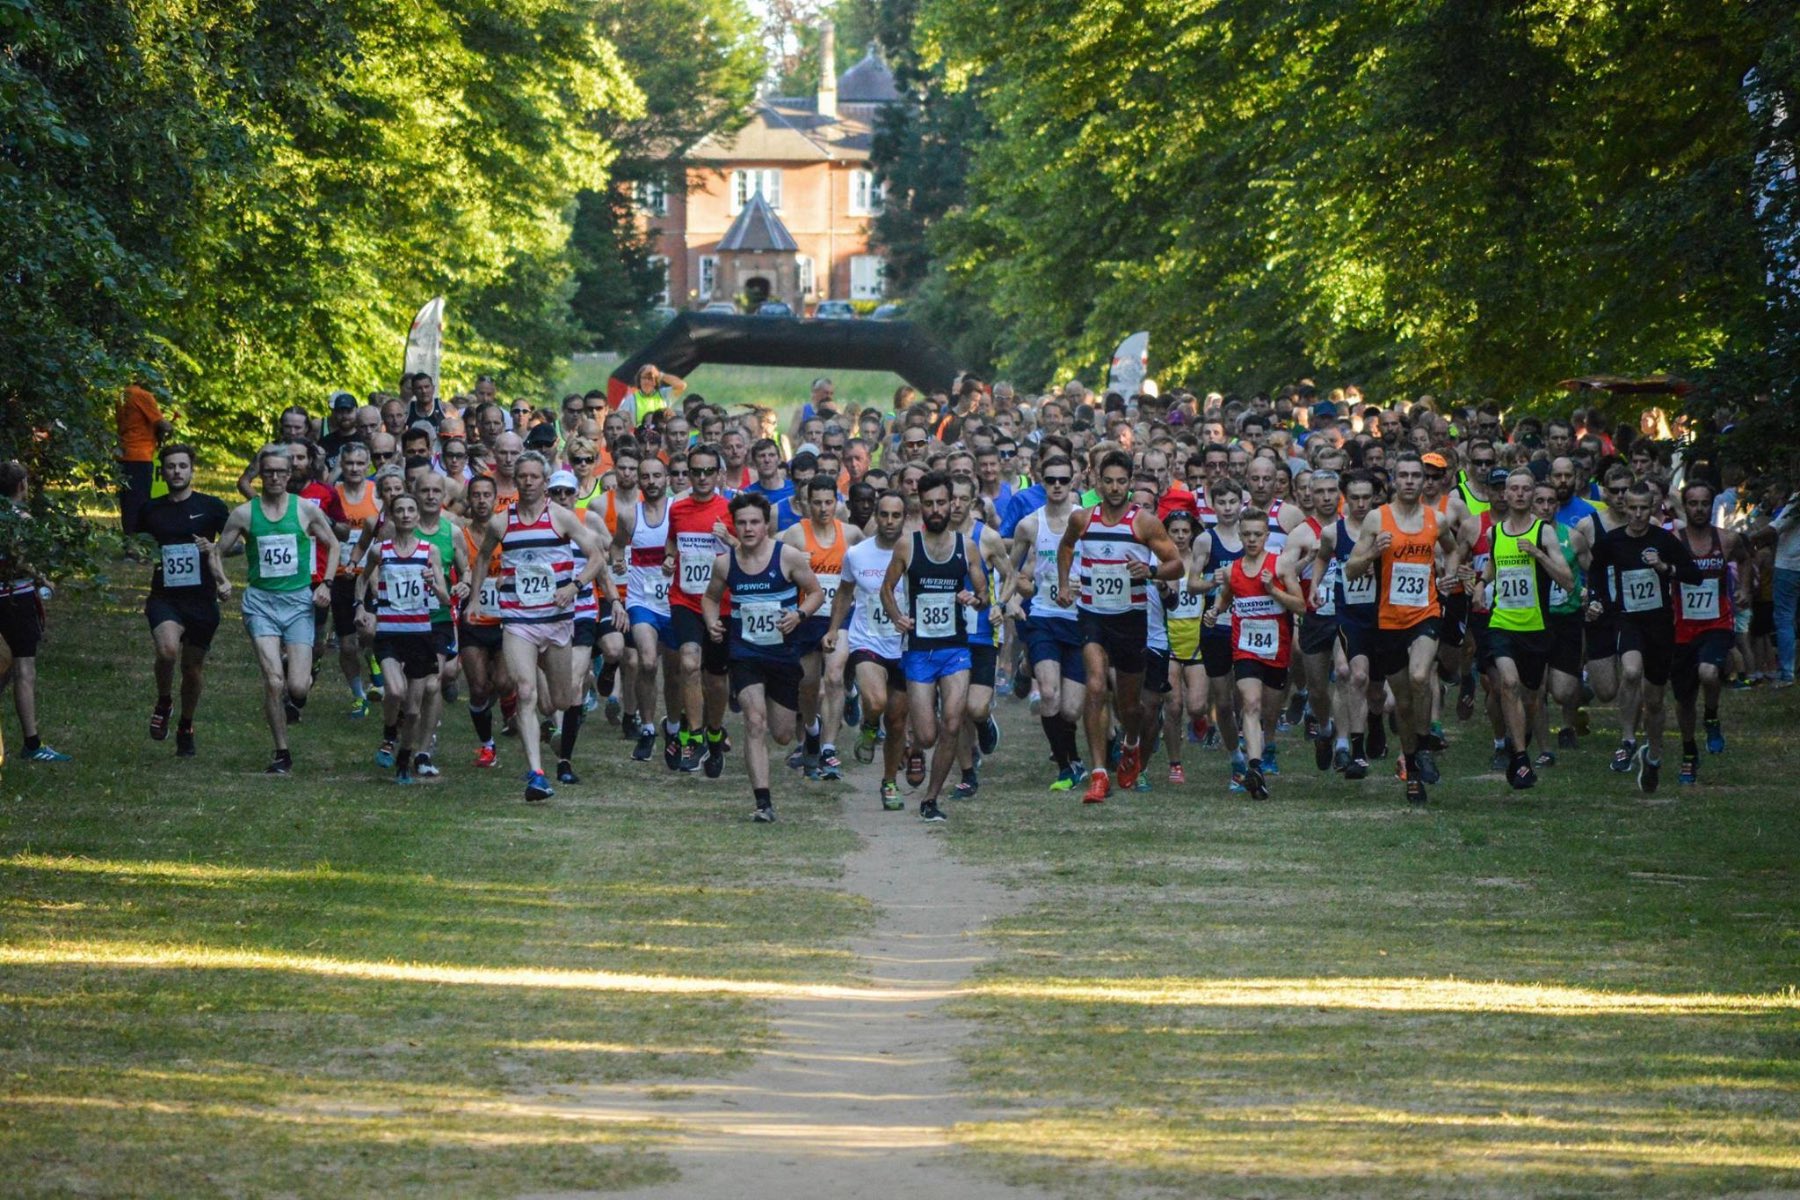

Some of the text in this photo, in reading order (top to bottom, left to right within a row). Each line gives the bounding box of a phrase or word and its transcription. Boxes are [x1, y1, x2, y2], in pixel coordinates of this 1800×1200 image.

[167, 556, 194, 575] 355
[264, 547, 292, 566] 456
[685, 565, 710, 583] 202
[395, 580, 420, 599] 176
[522, 576, 549, 595] 224
[736, 583, 770, 592] IPSWICH
[1095, 577, 1124, 596] 329
[1397, 576, 1424, 595] 233
[1501, 579, 1529, 598] 218
[1630, 582, 1655, 600] 122
[1687, 592, 1713, 609] 277
[747, 615, 775, 633] 245
[873, 607, 892, 625] 45
[922, 607, 949, 625] 385
[1247, 632, 1272, 648] 184
